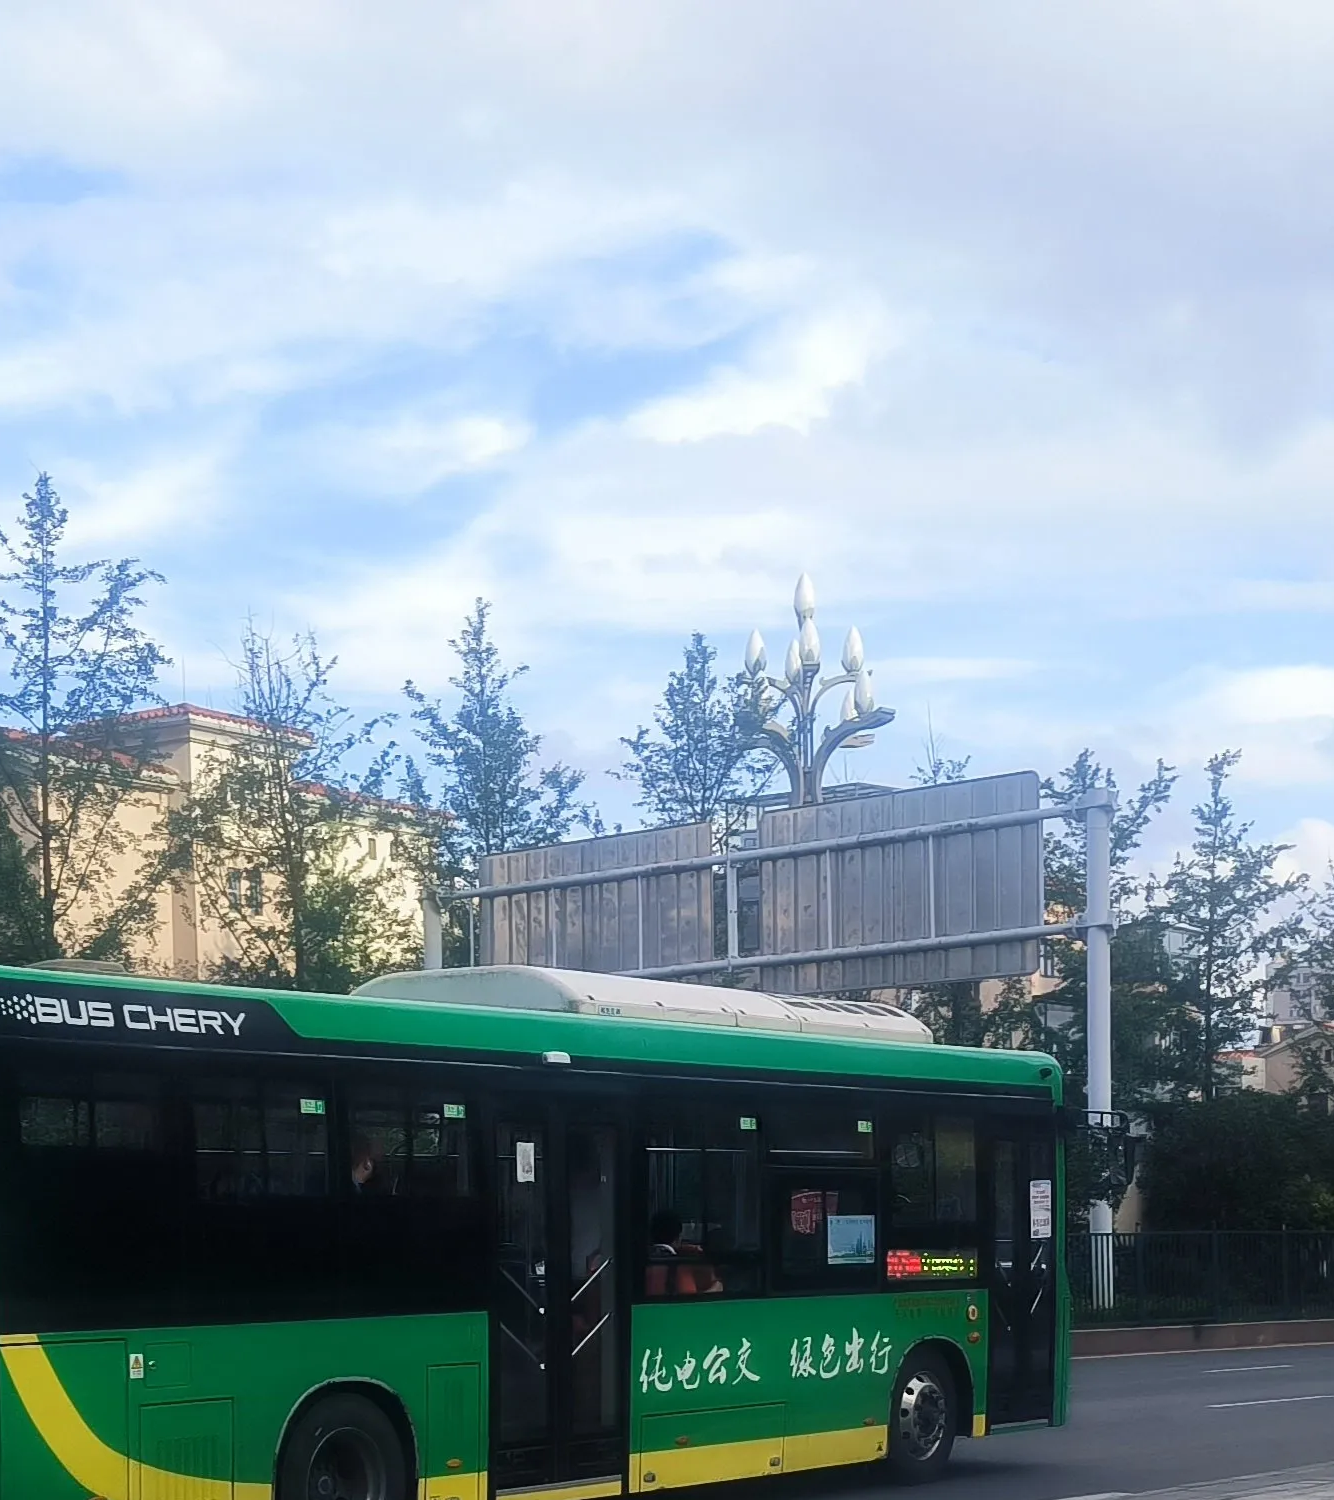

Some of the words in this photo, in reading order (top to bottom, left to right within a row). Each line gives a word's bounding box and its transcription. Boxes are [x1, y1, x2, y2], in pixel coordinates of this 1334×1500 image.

[34, 996, 115, 1027] BUS
[123, 1004, 246, 1036] CHERY
[639, 1337, 761, 1393] 纯电公交
[790, 1326, 893, 1379] 绿色出行
